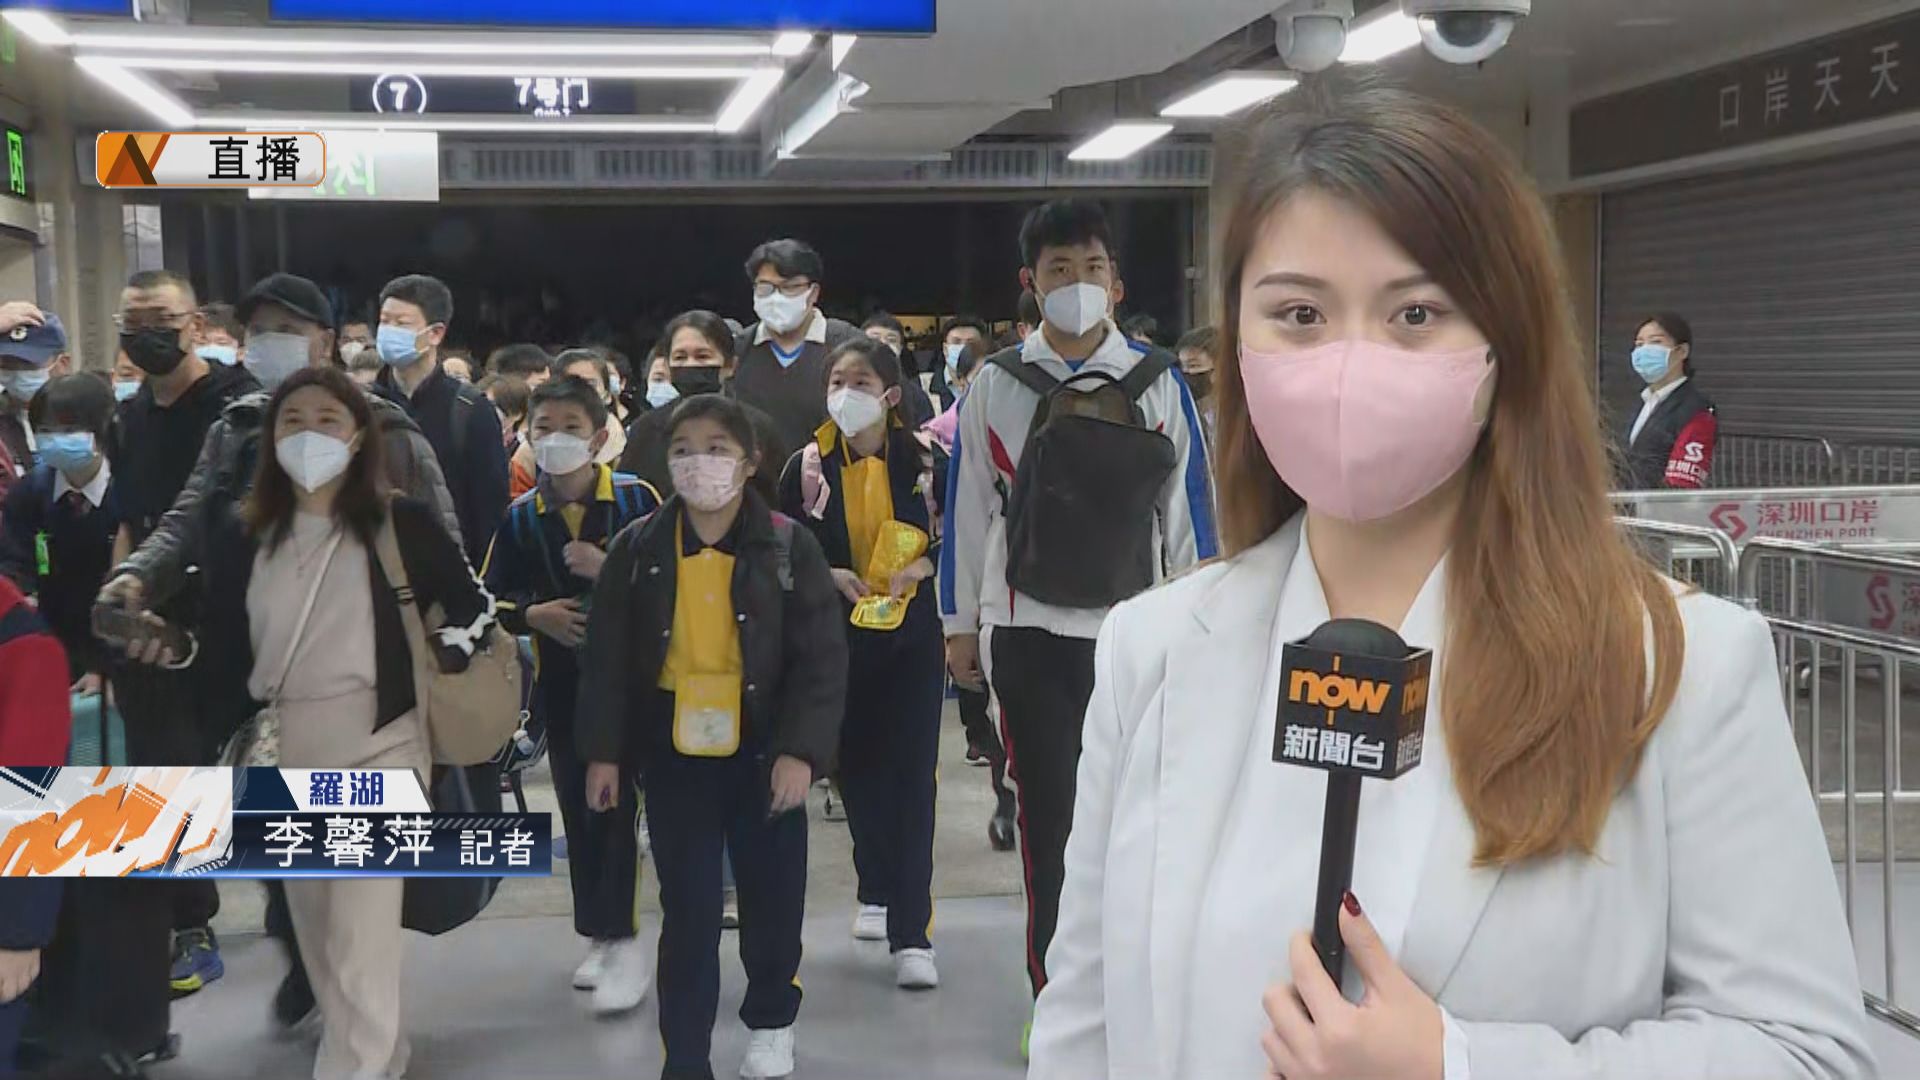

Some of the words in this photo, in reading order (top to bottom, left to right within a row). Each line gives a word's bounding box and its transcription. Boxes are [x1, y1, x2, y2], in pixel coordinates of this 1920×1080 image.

[389, 82, 408, 111] 7
[1718, 41, 1900, 131] 口岸天天
[1756, 499, 1879, 525] 深圳口岸
[1838, 526, 1877, 538] PORT
[1288, 669, 1392, 714] now
[1282, 723, 1385, 770] 新聞台
